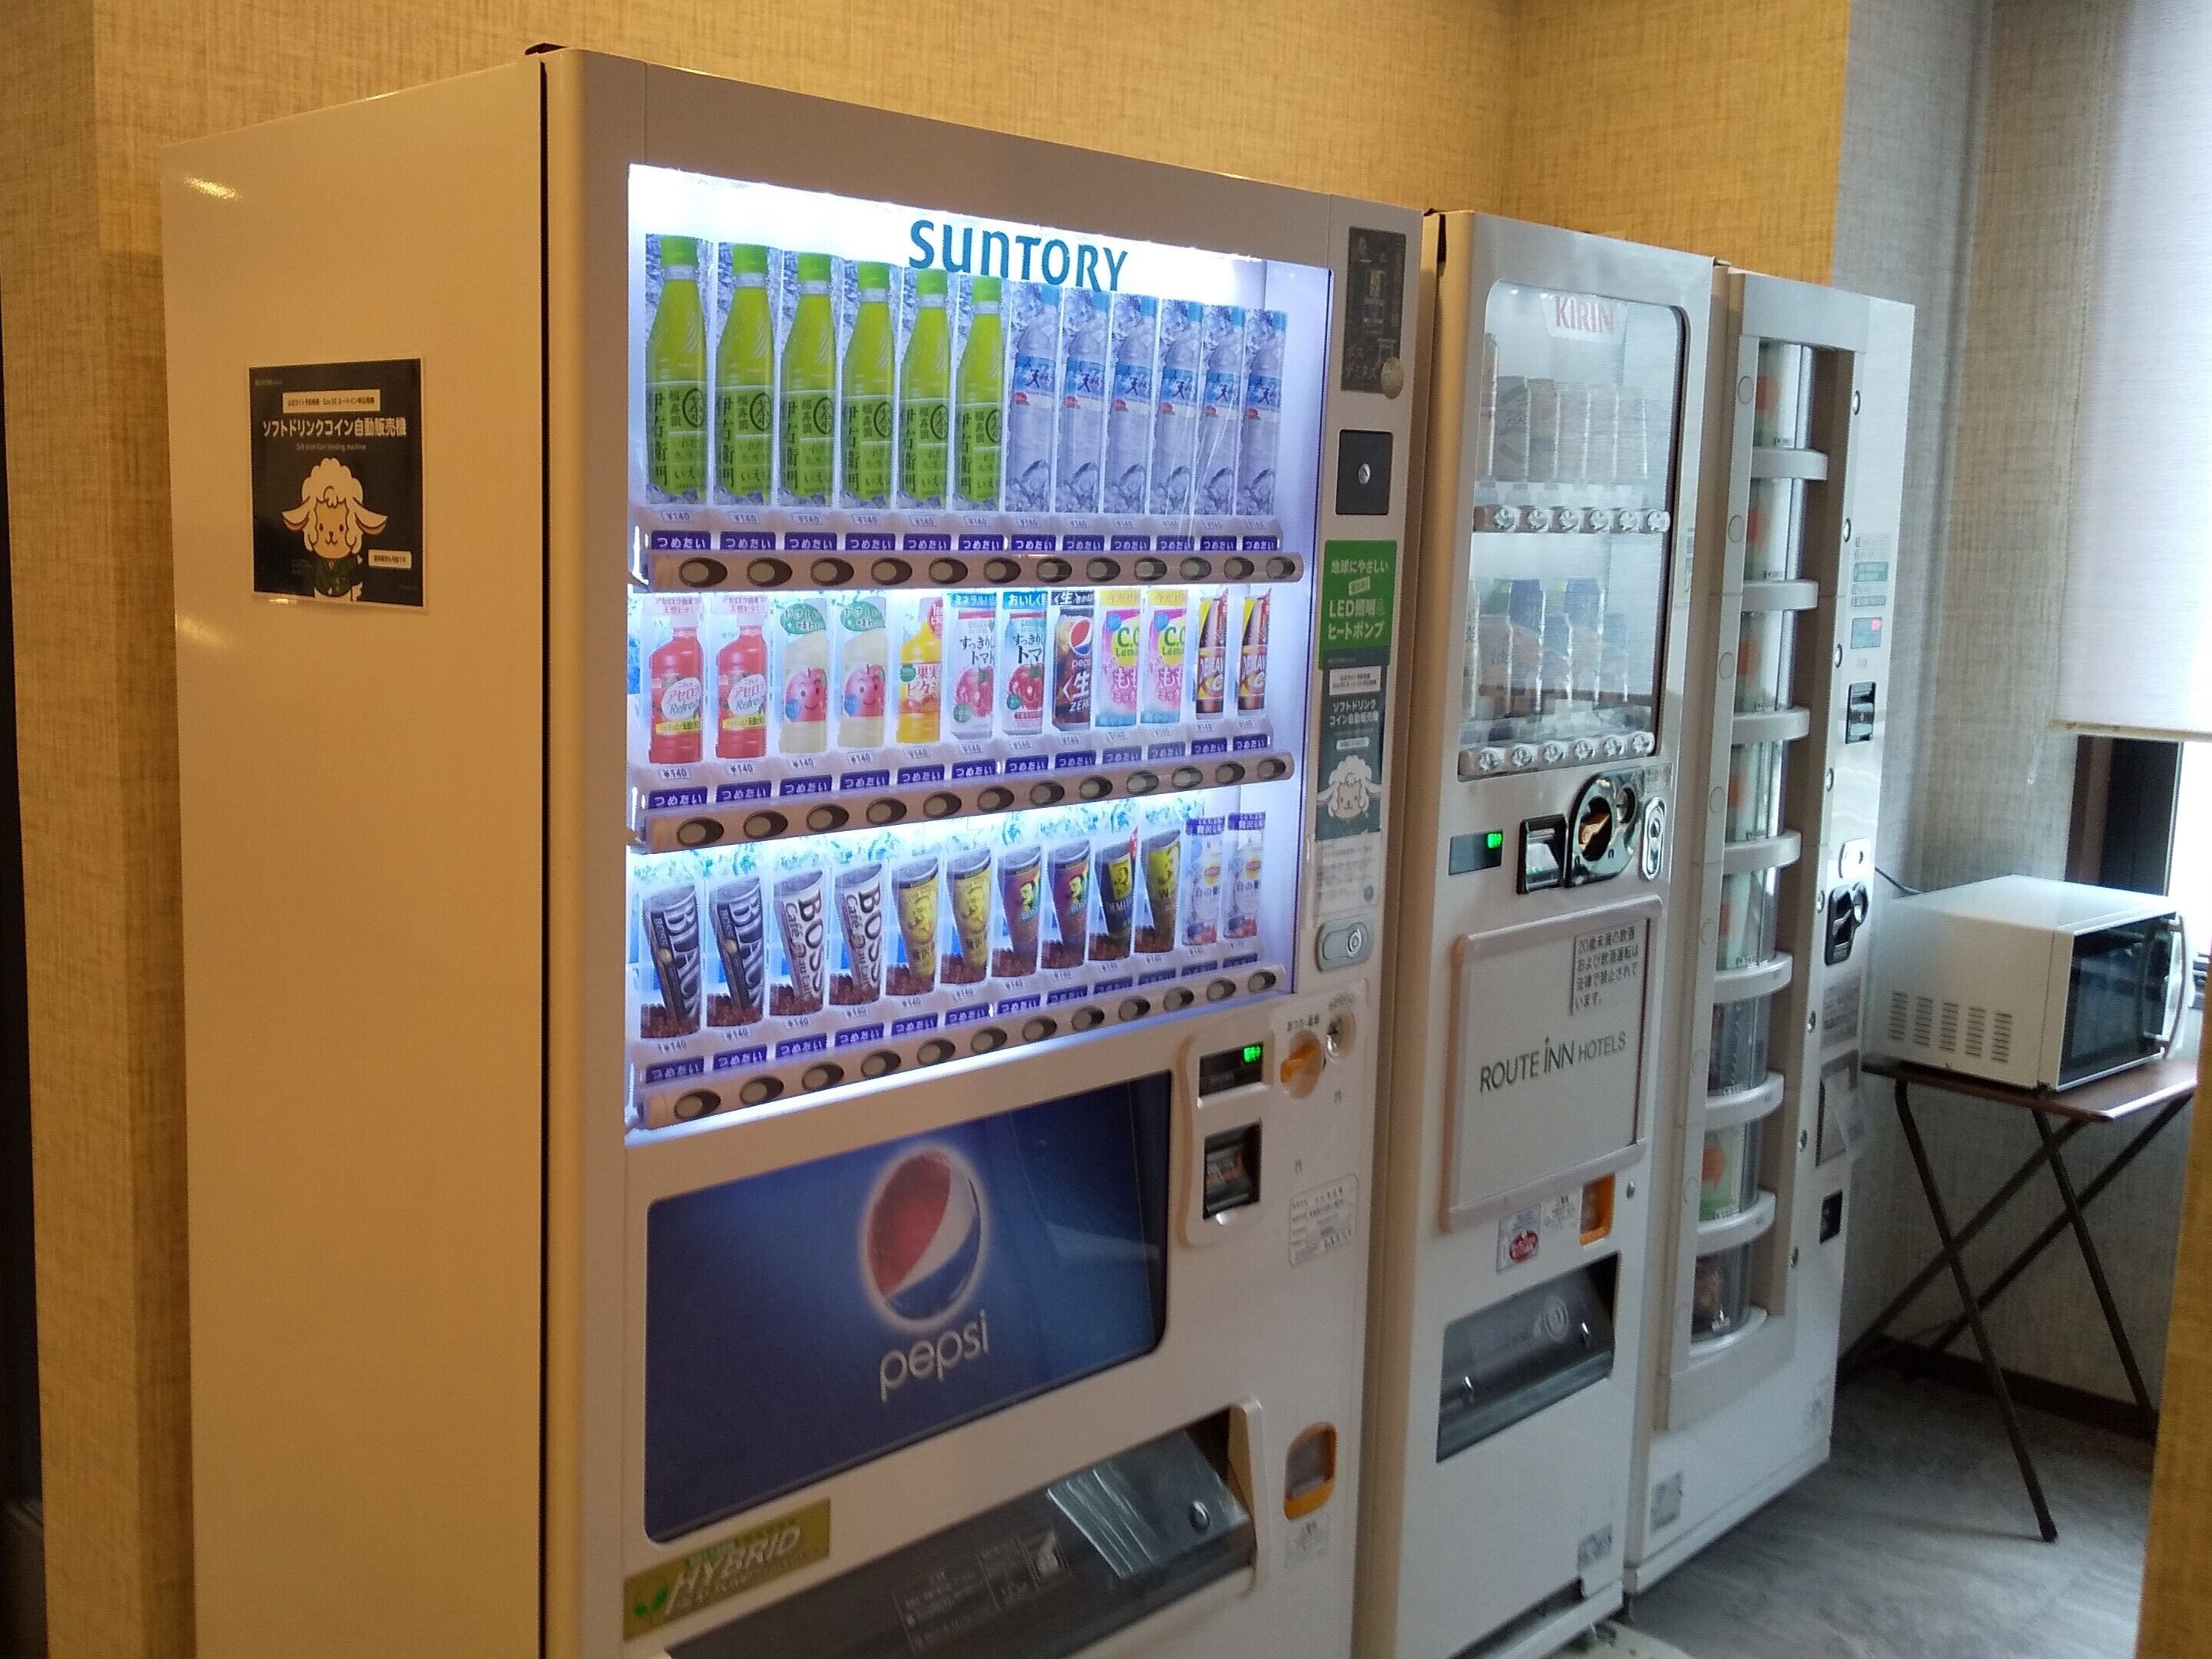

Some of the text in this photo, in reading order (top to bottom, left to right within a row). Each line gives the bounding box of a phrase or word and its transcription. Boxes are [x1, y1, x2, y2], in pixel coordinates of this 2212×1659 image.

[909, 220, 1128, 292] SUNTORY
[1555, 296, 1614, 334] KIRIN
[263, 416, 407, 437] ソフトドリンクコイン自動販売機
[667, 512, 690, 521] ¥140
[734, 513, 757, 522] ¥140
[657, 537, 705, 549] つめたい
[726, 538, 770, 549] つめたい
[790, 538, 832, 549] つめたい
[849, 538, 891, 549] つめたい
[908, 539, 946, 550] つめたい
[962, 540, 999, 550] つめたい
[1015, 540, 1052, 550] つめたい
[1066, 541, 1101, 550] つめたい
[1114, 541, 1147, 550] つめたい
[1203, 541, 1233, 550] つめたい
[1245, 541, 1274, 550] つめたい
[1331, 559, 1389, 574] 地球にやさしい
[1328, 620, 1385, 640] ヒートポンプ
[1018, 646, 1045, 664] トマ
[1071, 659, 1091, 670] peps
[918, 664, 938, 680] 果実
[1069, 700, 1089, 712] ZER
[1333, 699, 1376, 713] ソフトドリンク
[793, 758, 814, 767] ¥140
[849, 753, 871, 763] ¥140
[730, 763, 753, 773] ¥140
[956, 765, 992, 777] つめたい
[1009, 760, 1044, 773] つめたい
[664, 769, 687, 778] ¥140
[902, 770, 940, 783] つめたい
[785, 782, 827, 794] つめたい
[846, 776, 884, 789] つめたい
[654, 793, 702, 807] つめたい
[722, 788, 767, 800] つめたい
[858, 883, 882, 983] BOSS
[799, 889, 824, 994] BOSS
[726, 1029, 748, 1040] ¥140
[780, 1041, 823, 1055] つめたい
[718, 1051, 762, 1068] つめたい
[1480, 1049, 1539, 1093] ROUTE
[1578, 1031, 1627, 1063] HOTELS
[880, 1308, 988, 1402] pepsi
